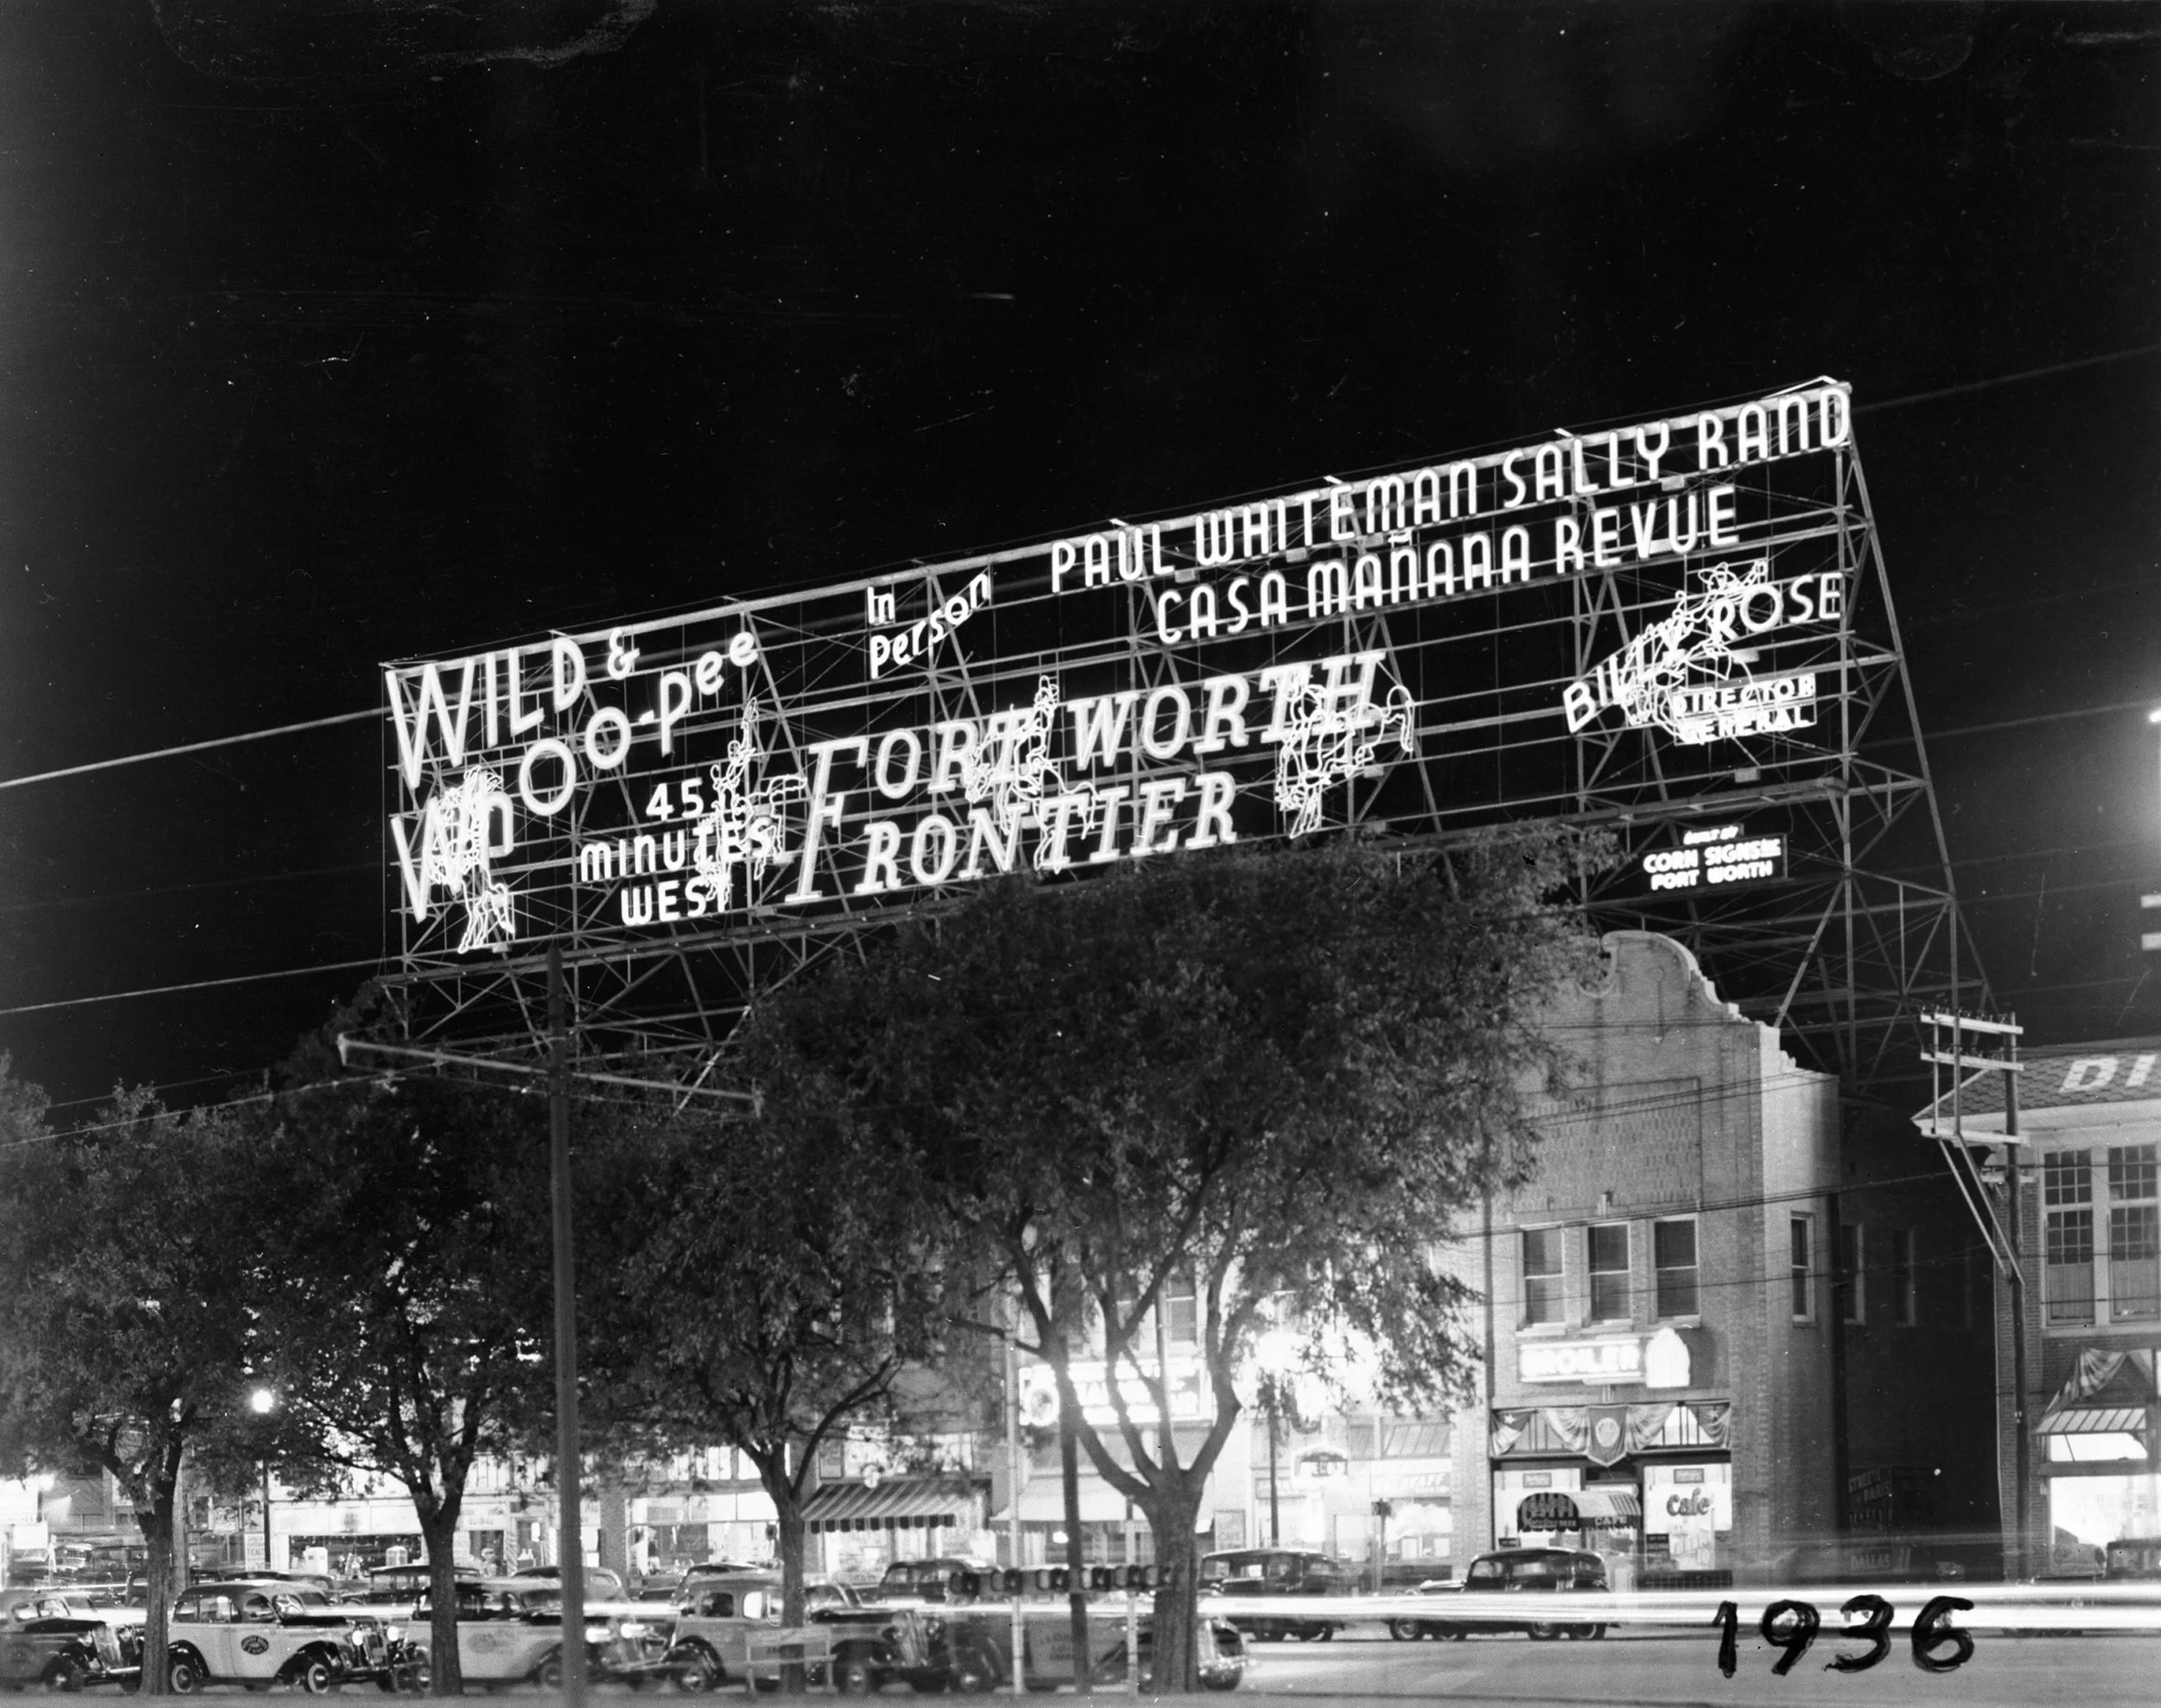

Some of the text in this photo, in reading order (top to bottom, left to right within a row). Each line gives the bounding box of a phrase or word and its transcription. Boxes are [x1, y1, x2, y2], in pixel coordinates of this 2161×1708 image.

[1052, 386, 1851, 593] PAUL WHITEMAN SALLY RAND
[1157, 570, 1288, 645] CASA
[1557, 486, 1740, 574] REVUE
[1709, 572, 1844, 640] ROSE
[386, 628, 641, 790] WILD &
[1067, 650, 1386, 770] WORTH
[1673, 673, 1815, 717] DIRECTOR
[1680, 706, 1811, 745] GENERAL
[646, 778, 704, 822] 45
[785, 737, 1237, 902] FRONTIER
[621, 875, 730, 926] WEST
[1707, 860, 1773, 883] WORTH
